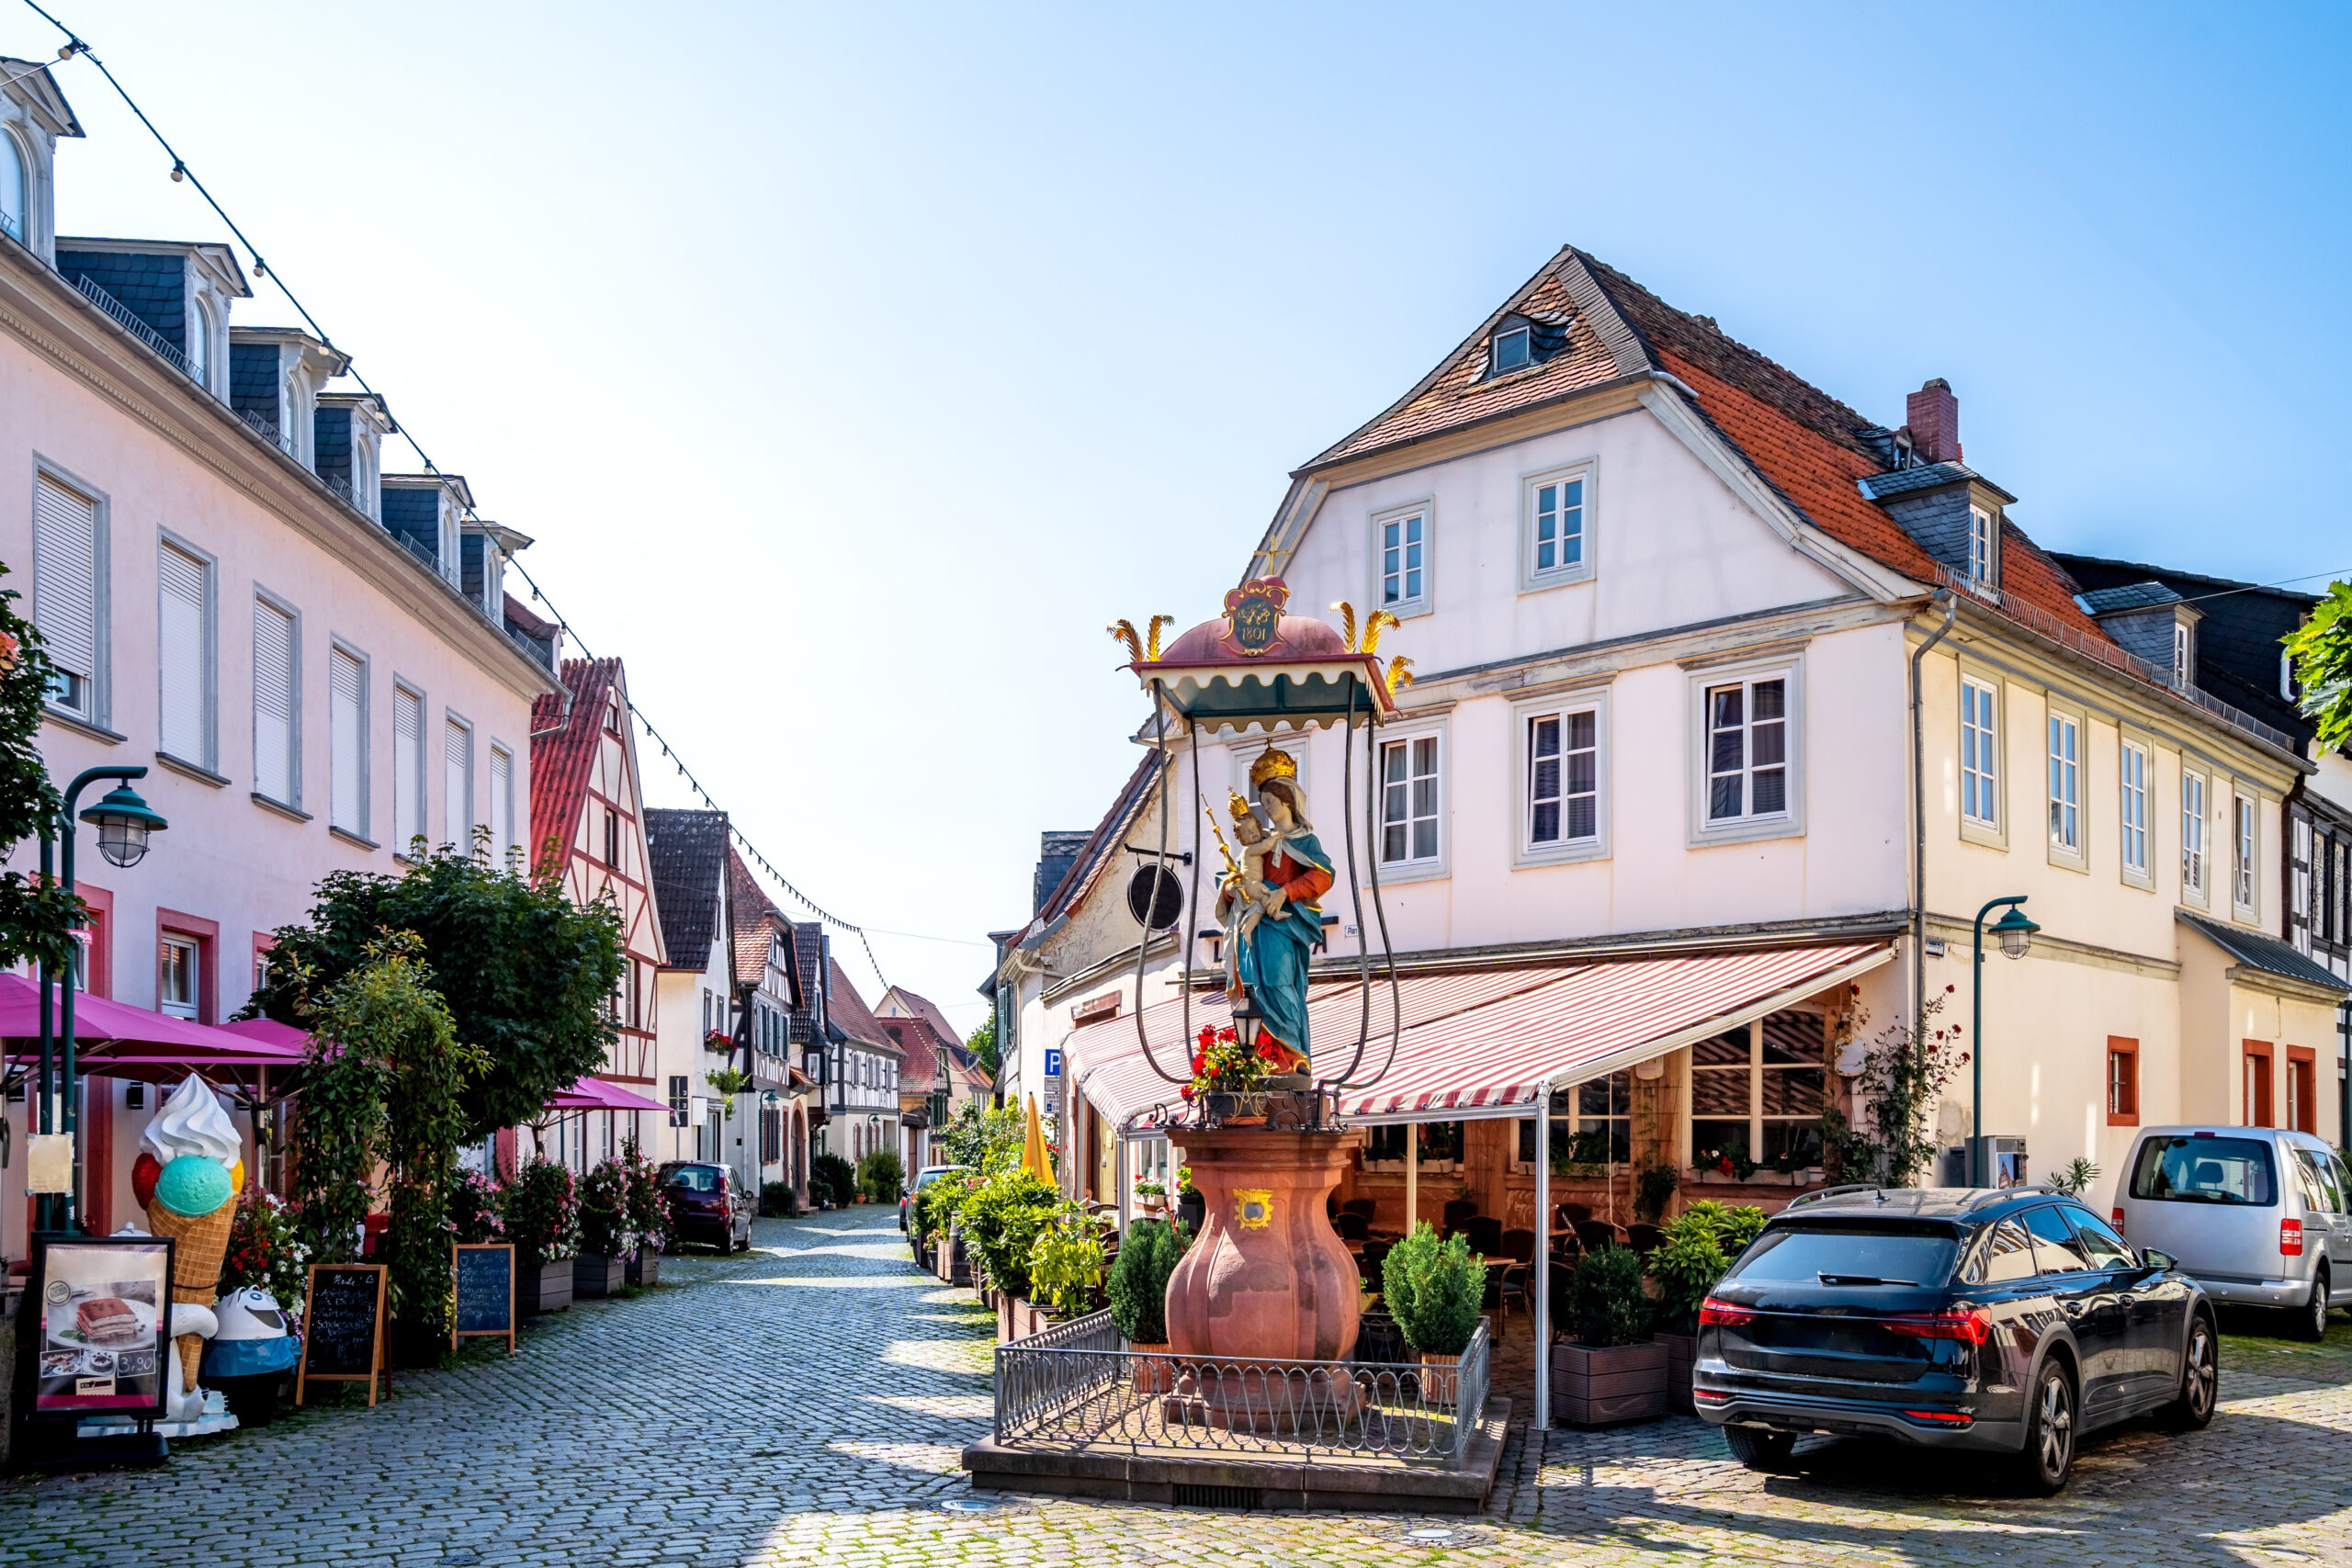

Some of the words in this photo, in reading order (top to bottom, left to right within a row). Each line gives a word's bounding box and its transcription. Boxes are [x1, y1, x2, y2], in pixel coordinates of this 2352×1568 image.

[1242, 627, 1266, 641] 1801
[1347, 927, 1358, 935] Plan
[1049, 1052, 1060, 1073] P
[119, 1357, 153, 1373] 3,90
